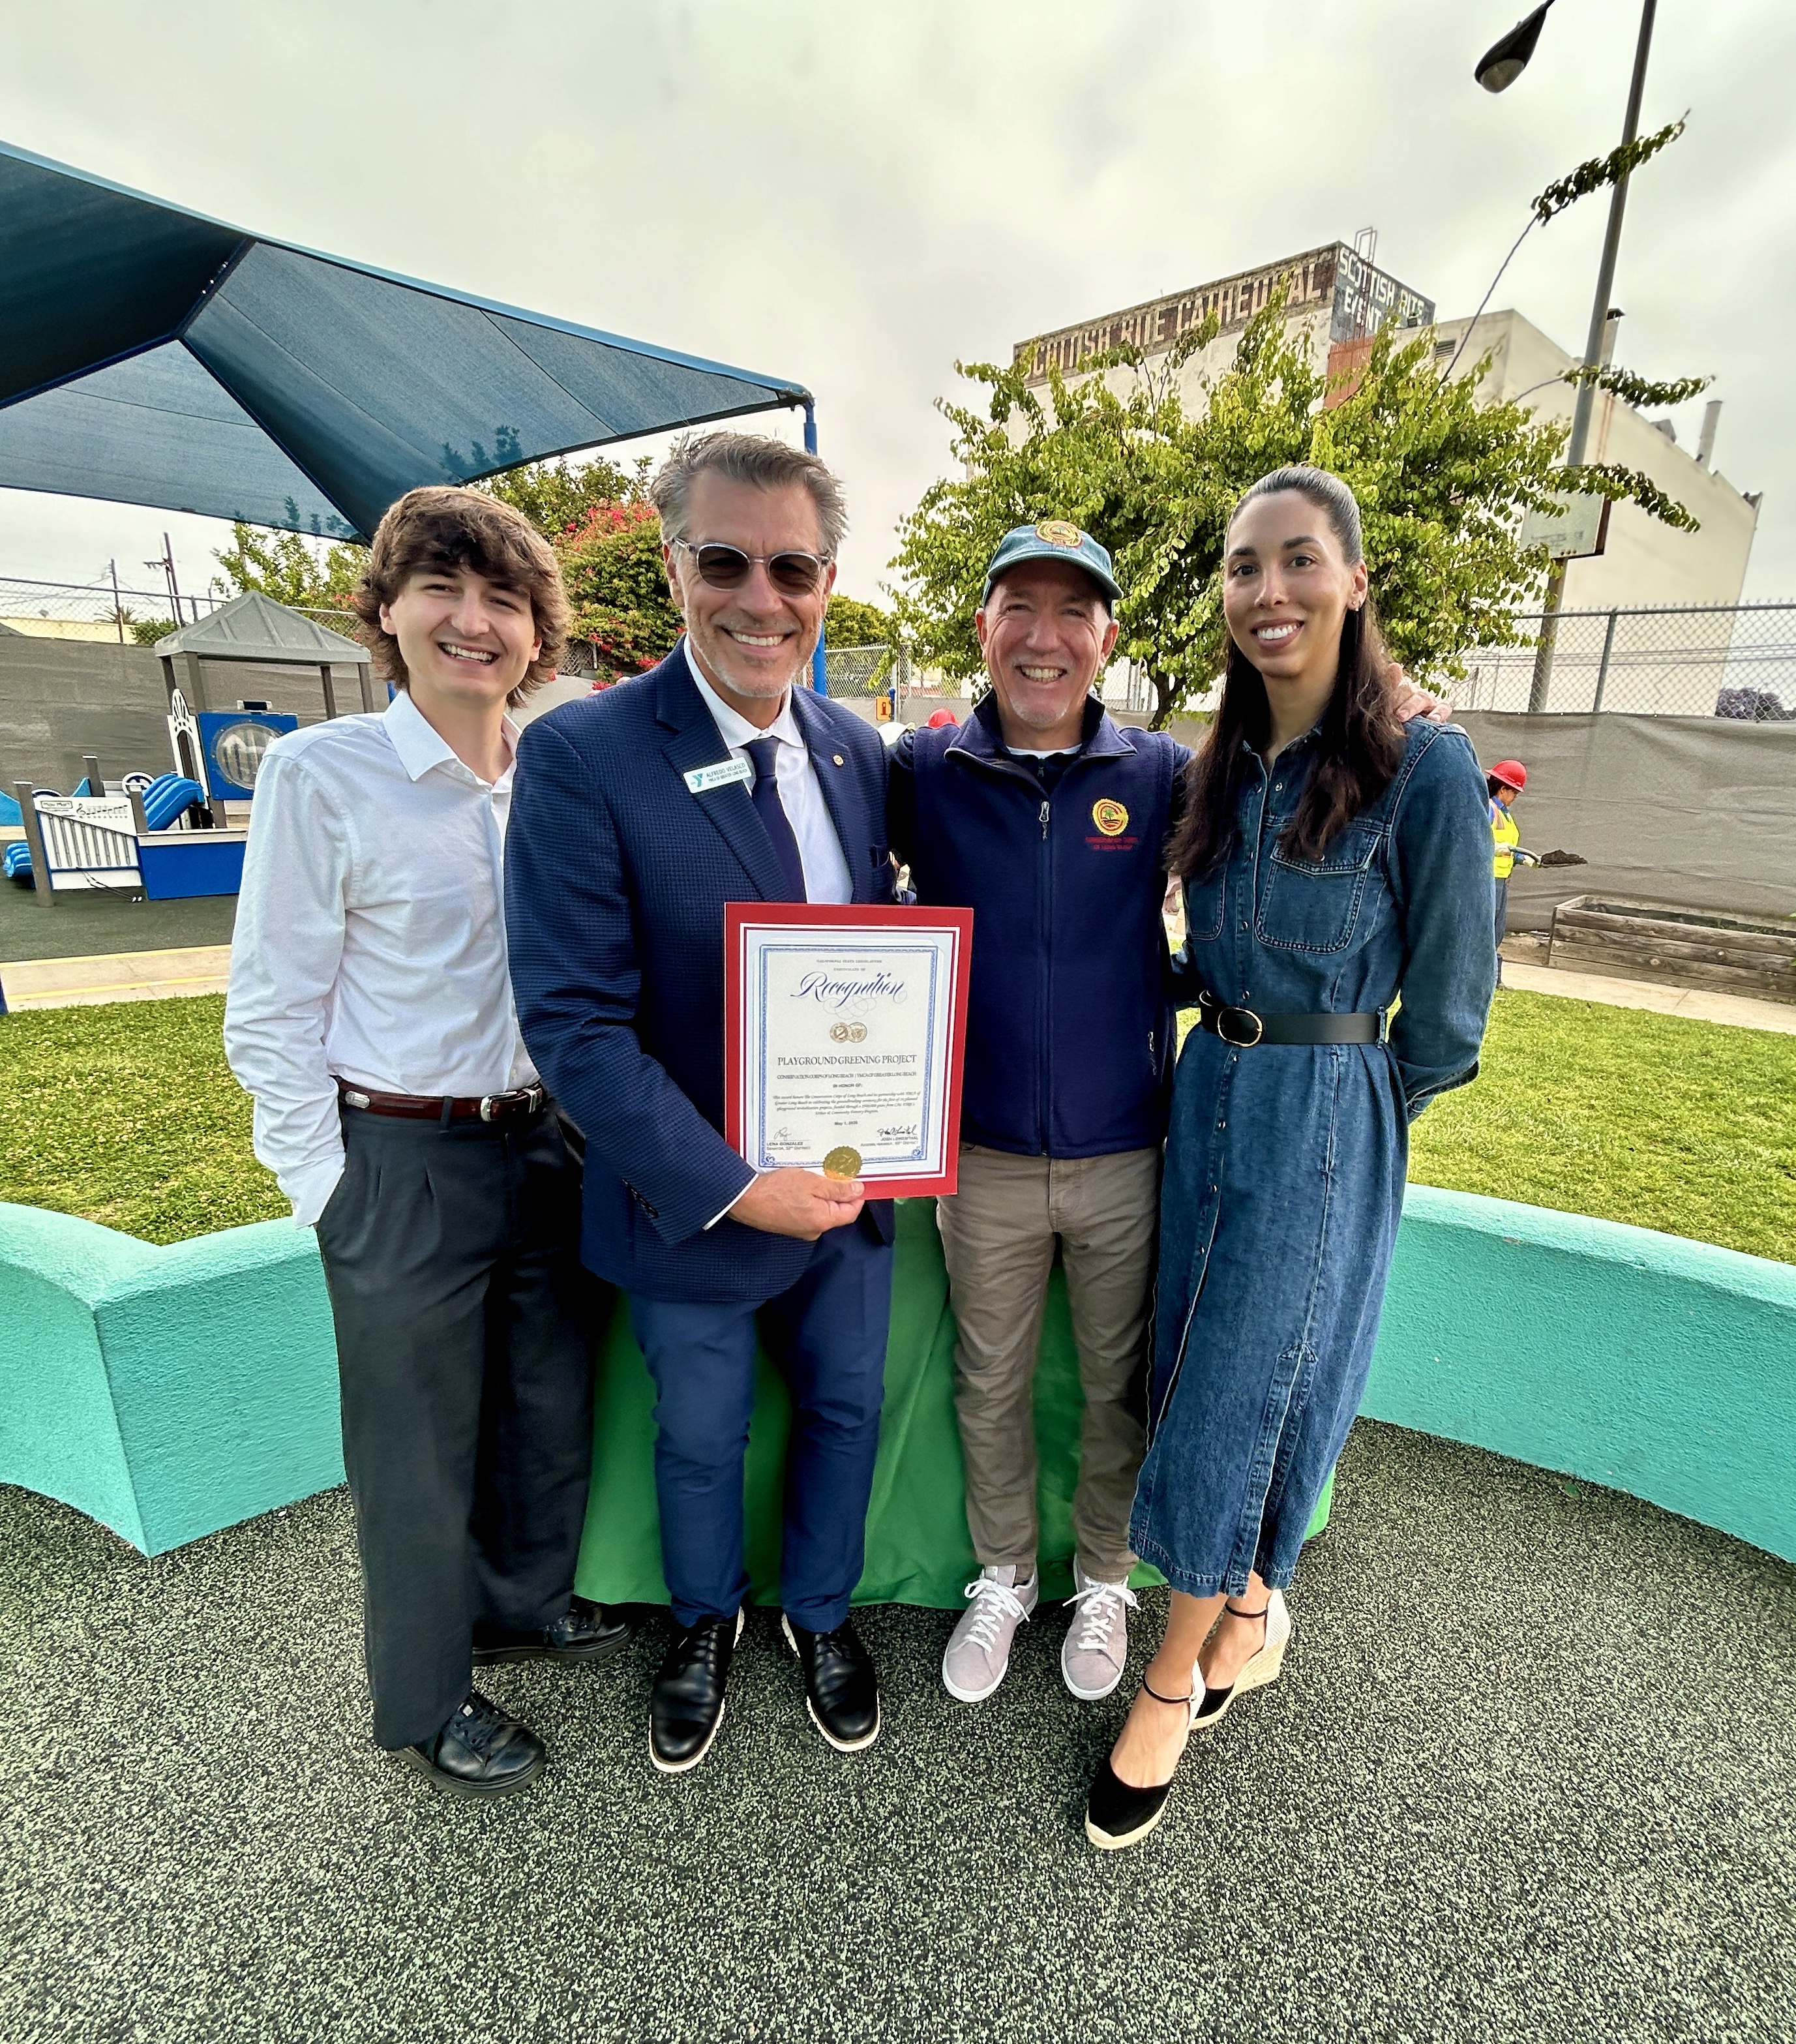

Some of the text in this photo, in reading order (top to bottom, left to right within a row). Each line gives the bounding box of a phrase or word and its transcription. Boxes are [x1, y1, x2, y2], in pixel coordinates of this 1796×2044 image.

[1339, 247, 1396, 307] SCOTTISH
[1021, 325, 1111, 380] COTTISH
[1176, 262, 1322, 335] CATHEDAL
[1344, 285, 1382, 335] EVENT
[706, 762, 745, 777] ALFREDO VELASCO
[790, 971, 907, 1008] Recognition
[777, 1055, 917, 1066] PLAYGROUND GREENING PROJECT
